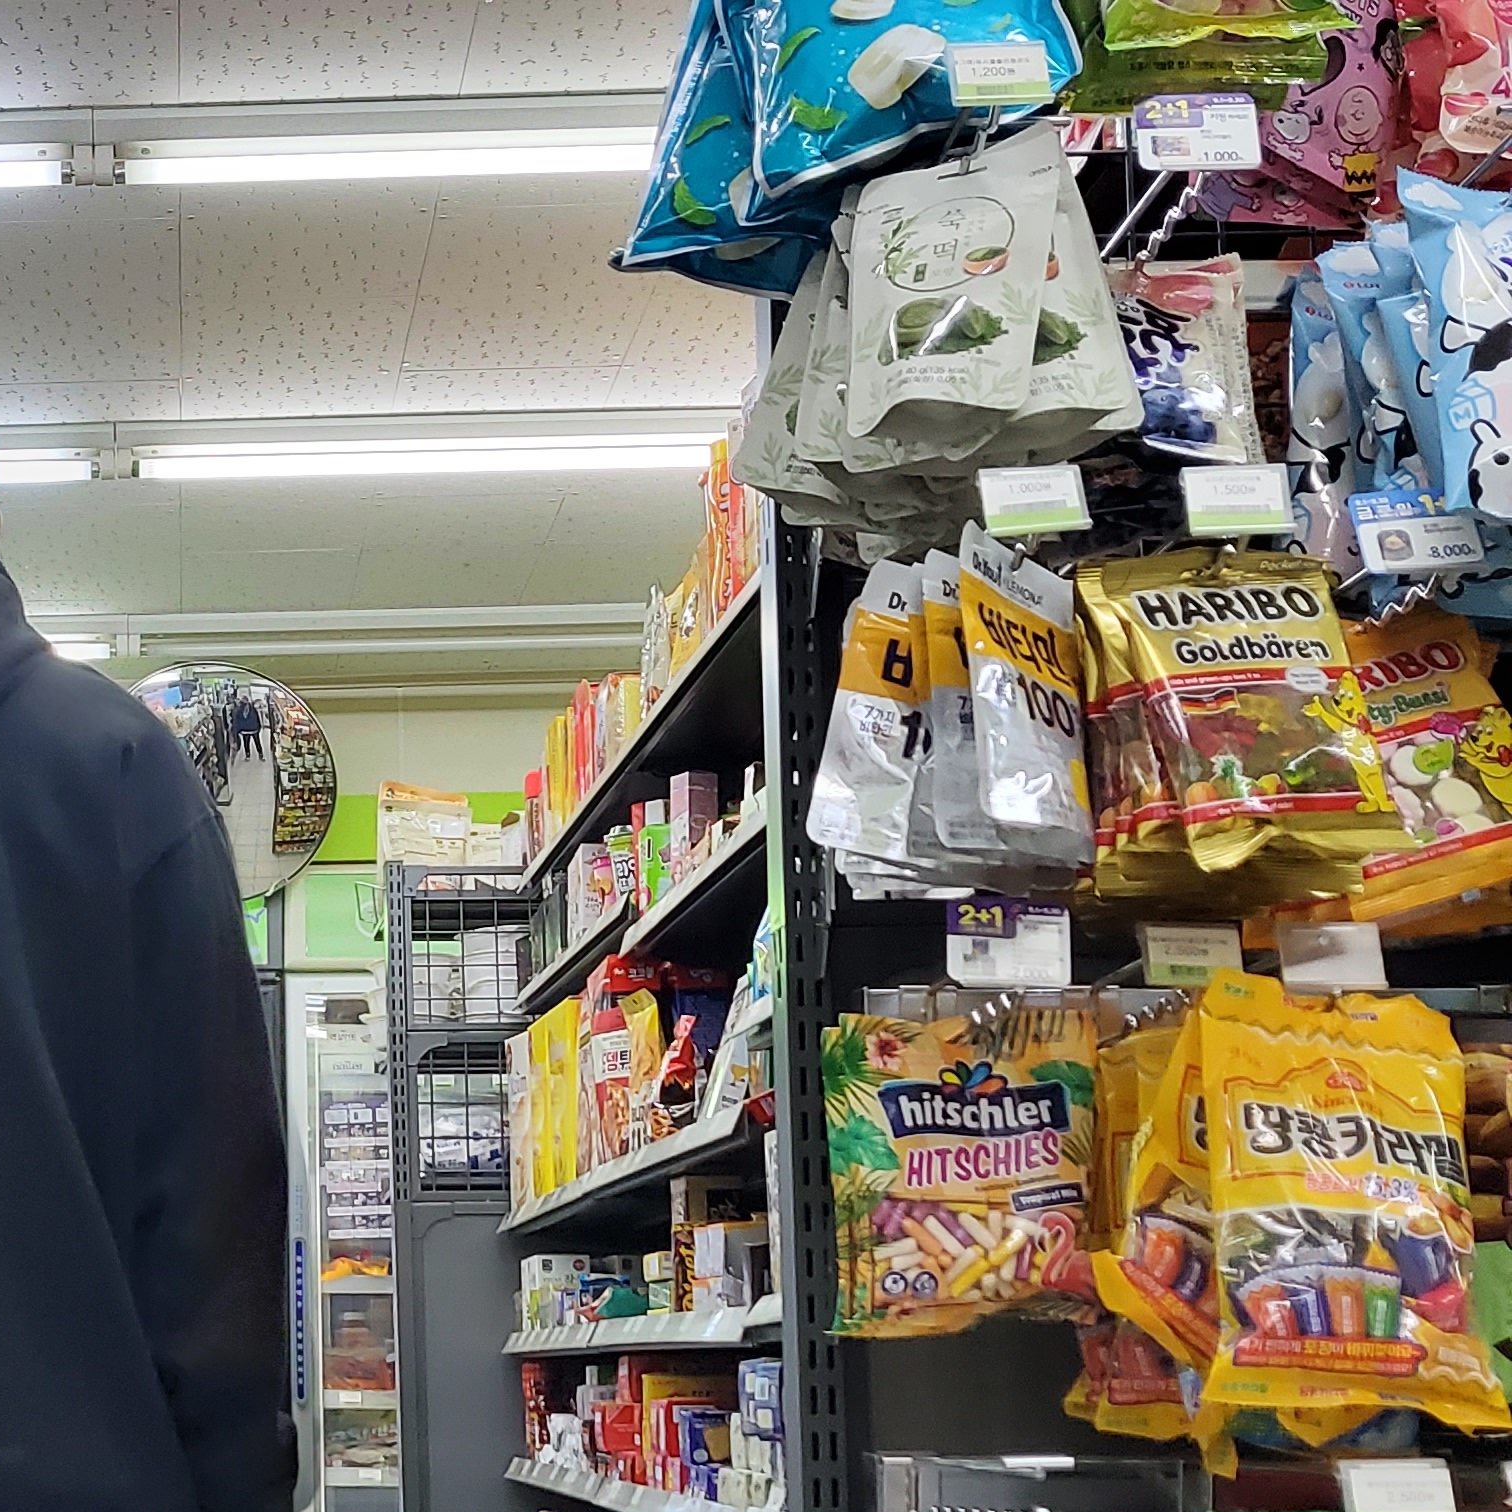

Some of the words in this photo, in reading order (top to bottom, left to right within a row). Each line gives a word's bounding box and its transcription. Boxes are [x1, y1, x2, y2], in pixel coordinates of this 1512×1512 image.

[1143, 100, 1190, 120] 2+1
[1138, 585, 1321, 628] HARIBO
[1174, 632, 1330, 664] Goldbären
[1356, 640, 1465, 692] RIBO
[1017, 671, 1076, 738] 100
[958, 905, 1004, 928] 2+1
[897, 1091, 1053, 1130] hitschler
[906, 1127, 1061, 1188] HITSCHIES
[1242, 1100, 1468, 1188] 땅콩카라멜
